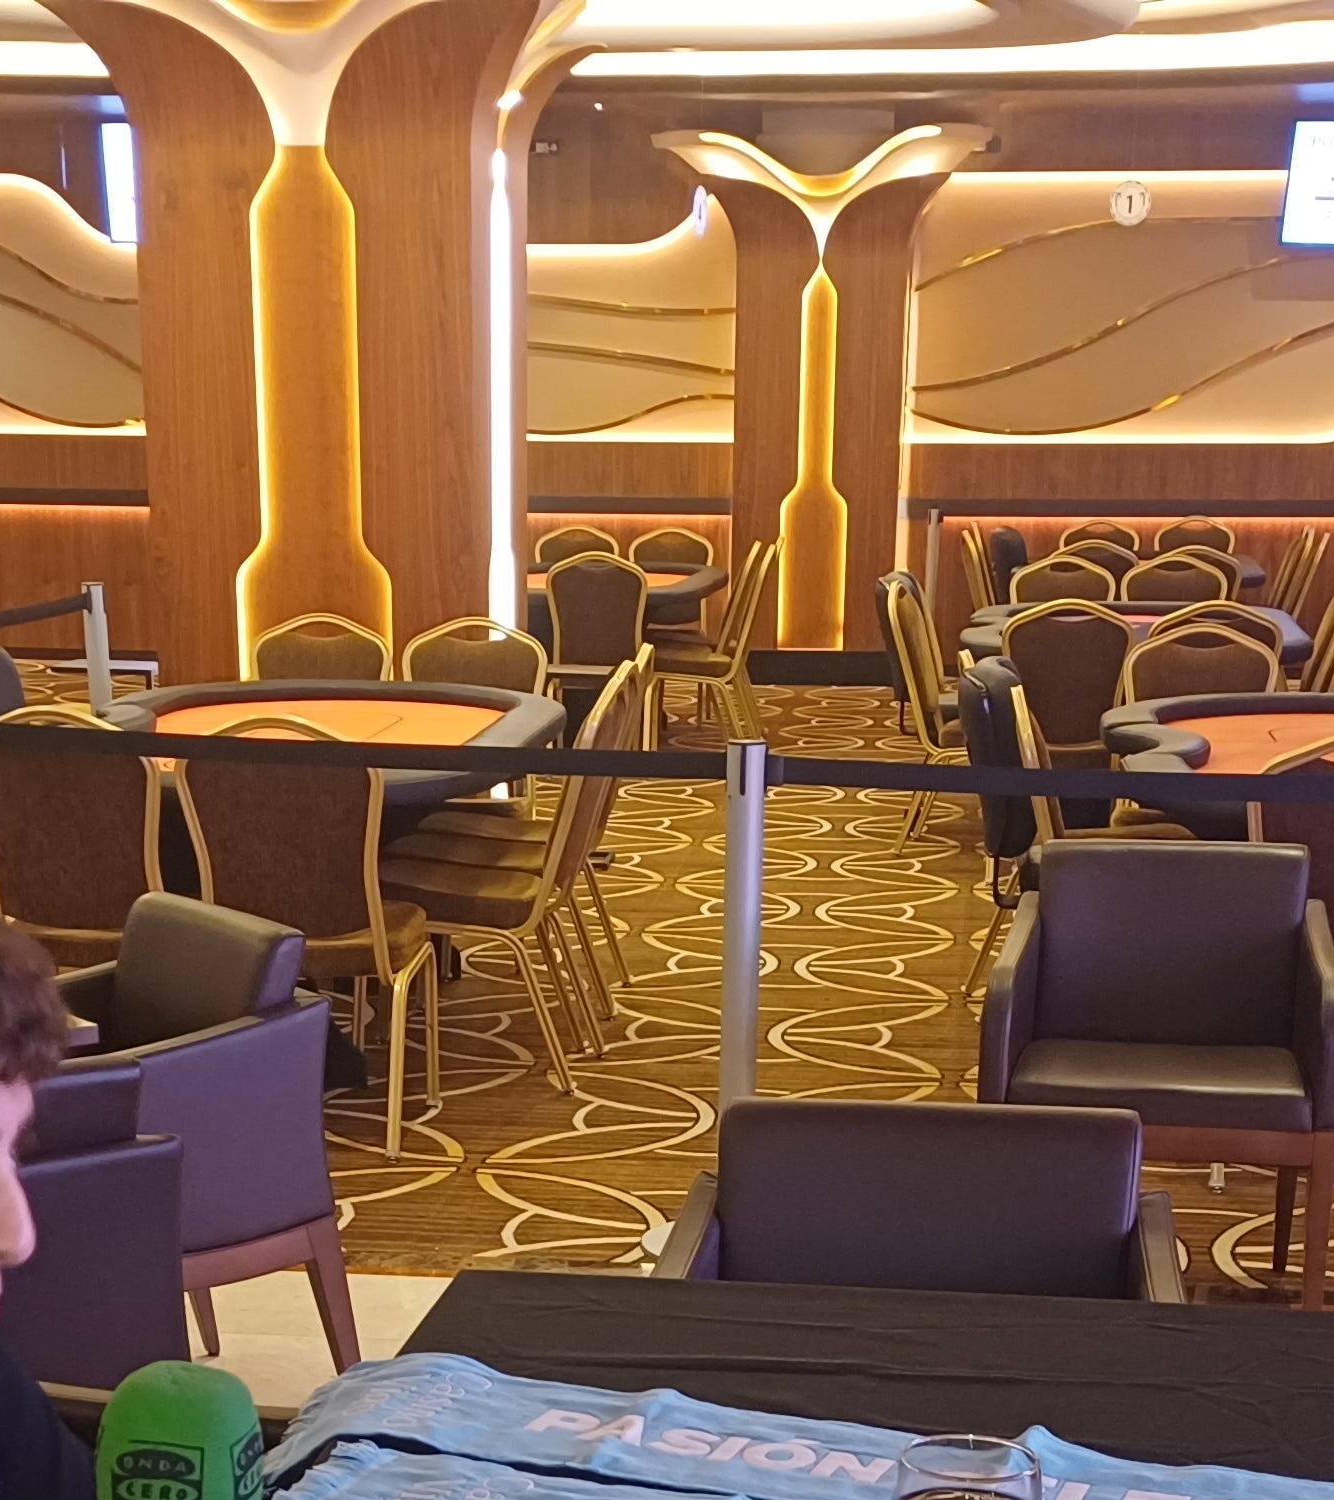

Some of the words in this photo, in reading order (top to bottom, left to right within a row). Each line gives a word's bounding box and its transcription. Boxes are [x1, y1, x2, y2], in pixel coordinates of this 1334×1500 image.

[1126, 194, 1133, 214] 1
[524, 1408, 898, 1484] PASIÓN
[122, 1455, 187, 1473] ONDA
